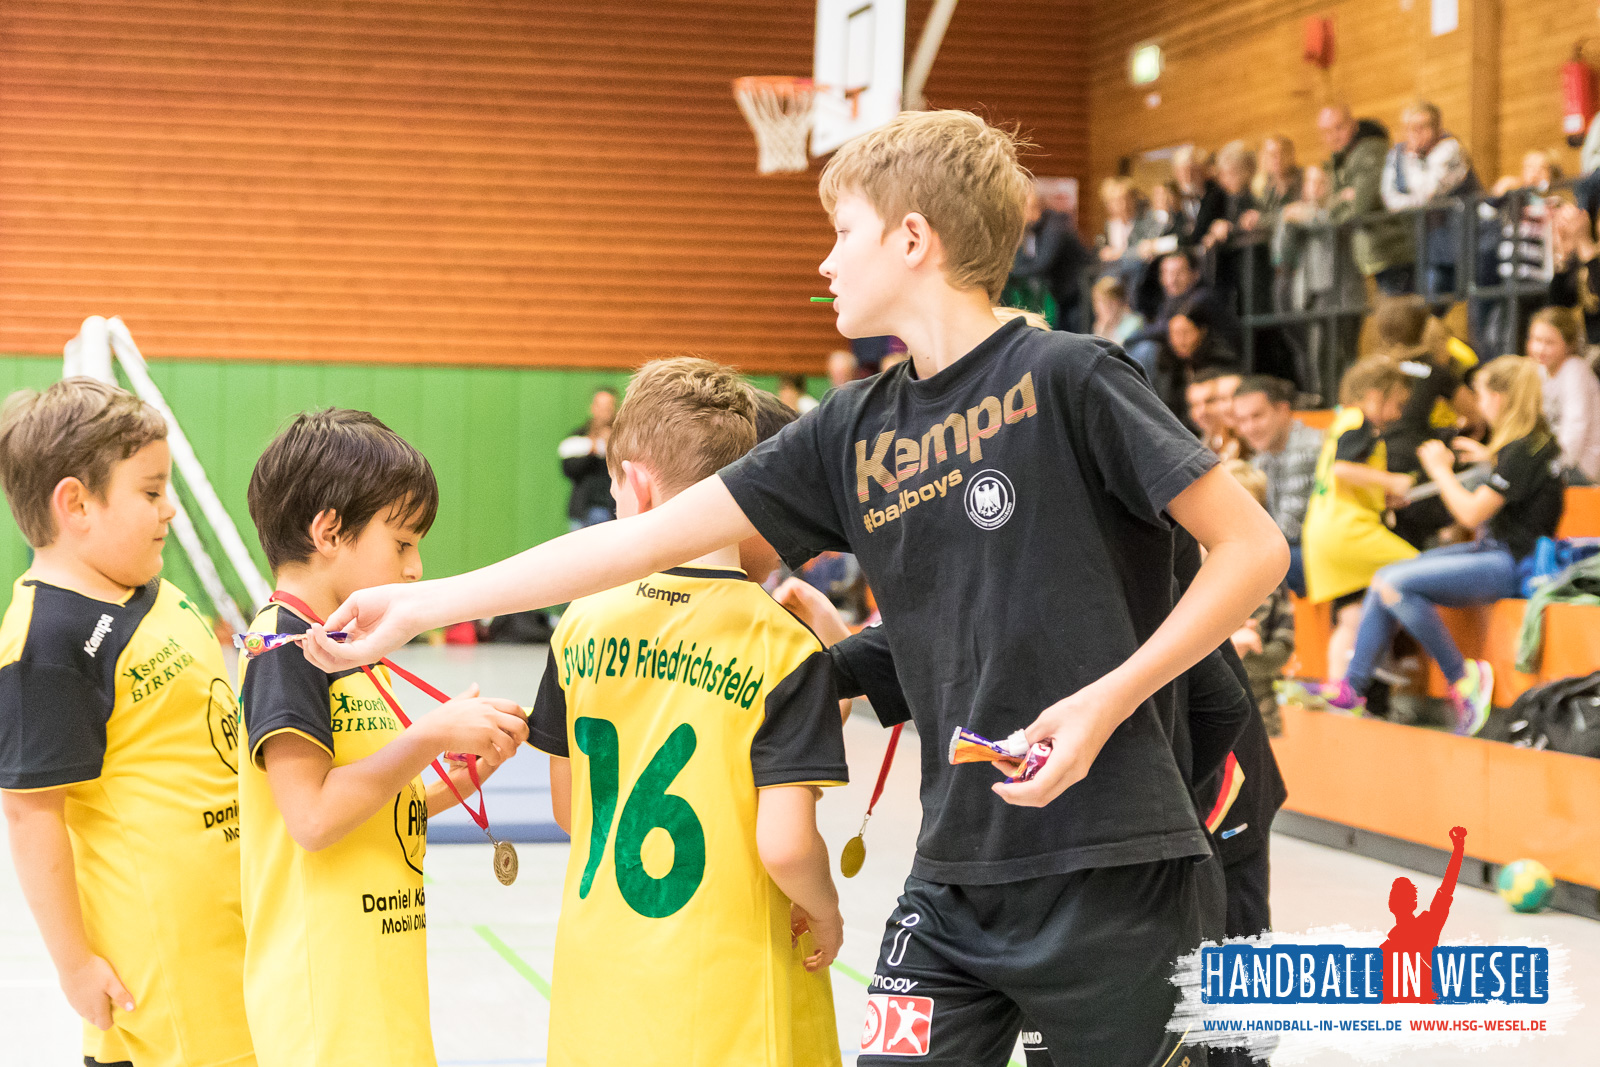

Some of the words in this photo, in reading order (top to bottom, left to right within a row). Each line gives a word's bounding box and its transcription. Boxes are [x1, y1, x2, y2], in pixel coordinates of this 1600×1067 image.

[855, 371, 1038, 504] Kempa
[863, 468, 963, 534] #badboys
[636, 582, 691, 606] Kempa
[83, 613, 115, 658] Kempa
[635, 636, 765, 711] Friedrichsfeld
[574, 715, 706, 919] 16
[362, 888, 411, 913] Daniel
[381, 914, 412, 935] Mobil
